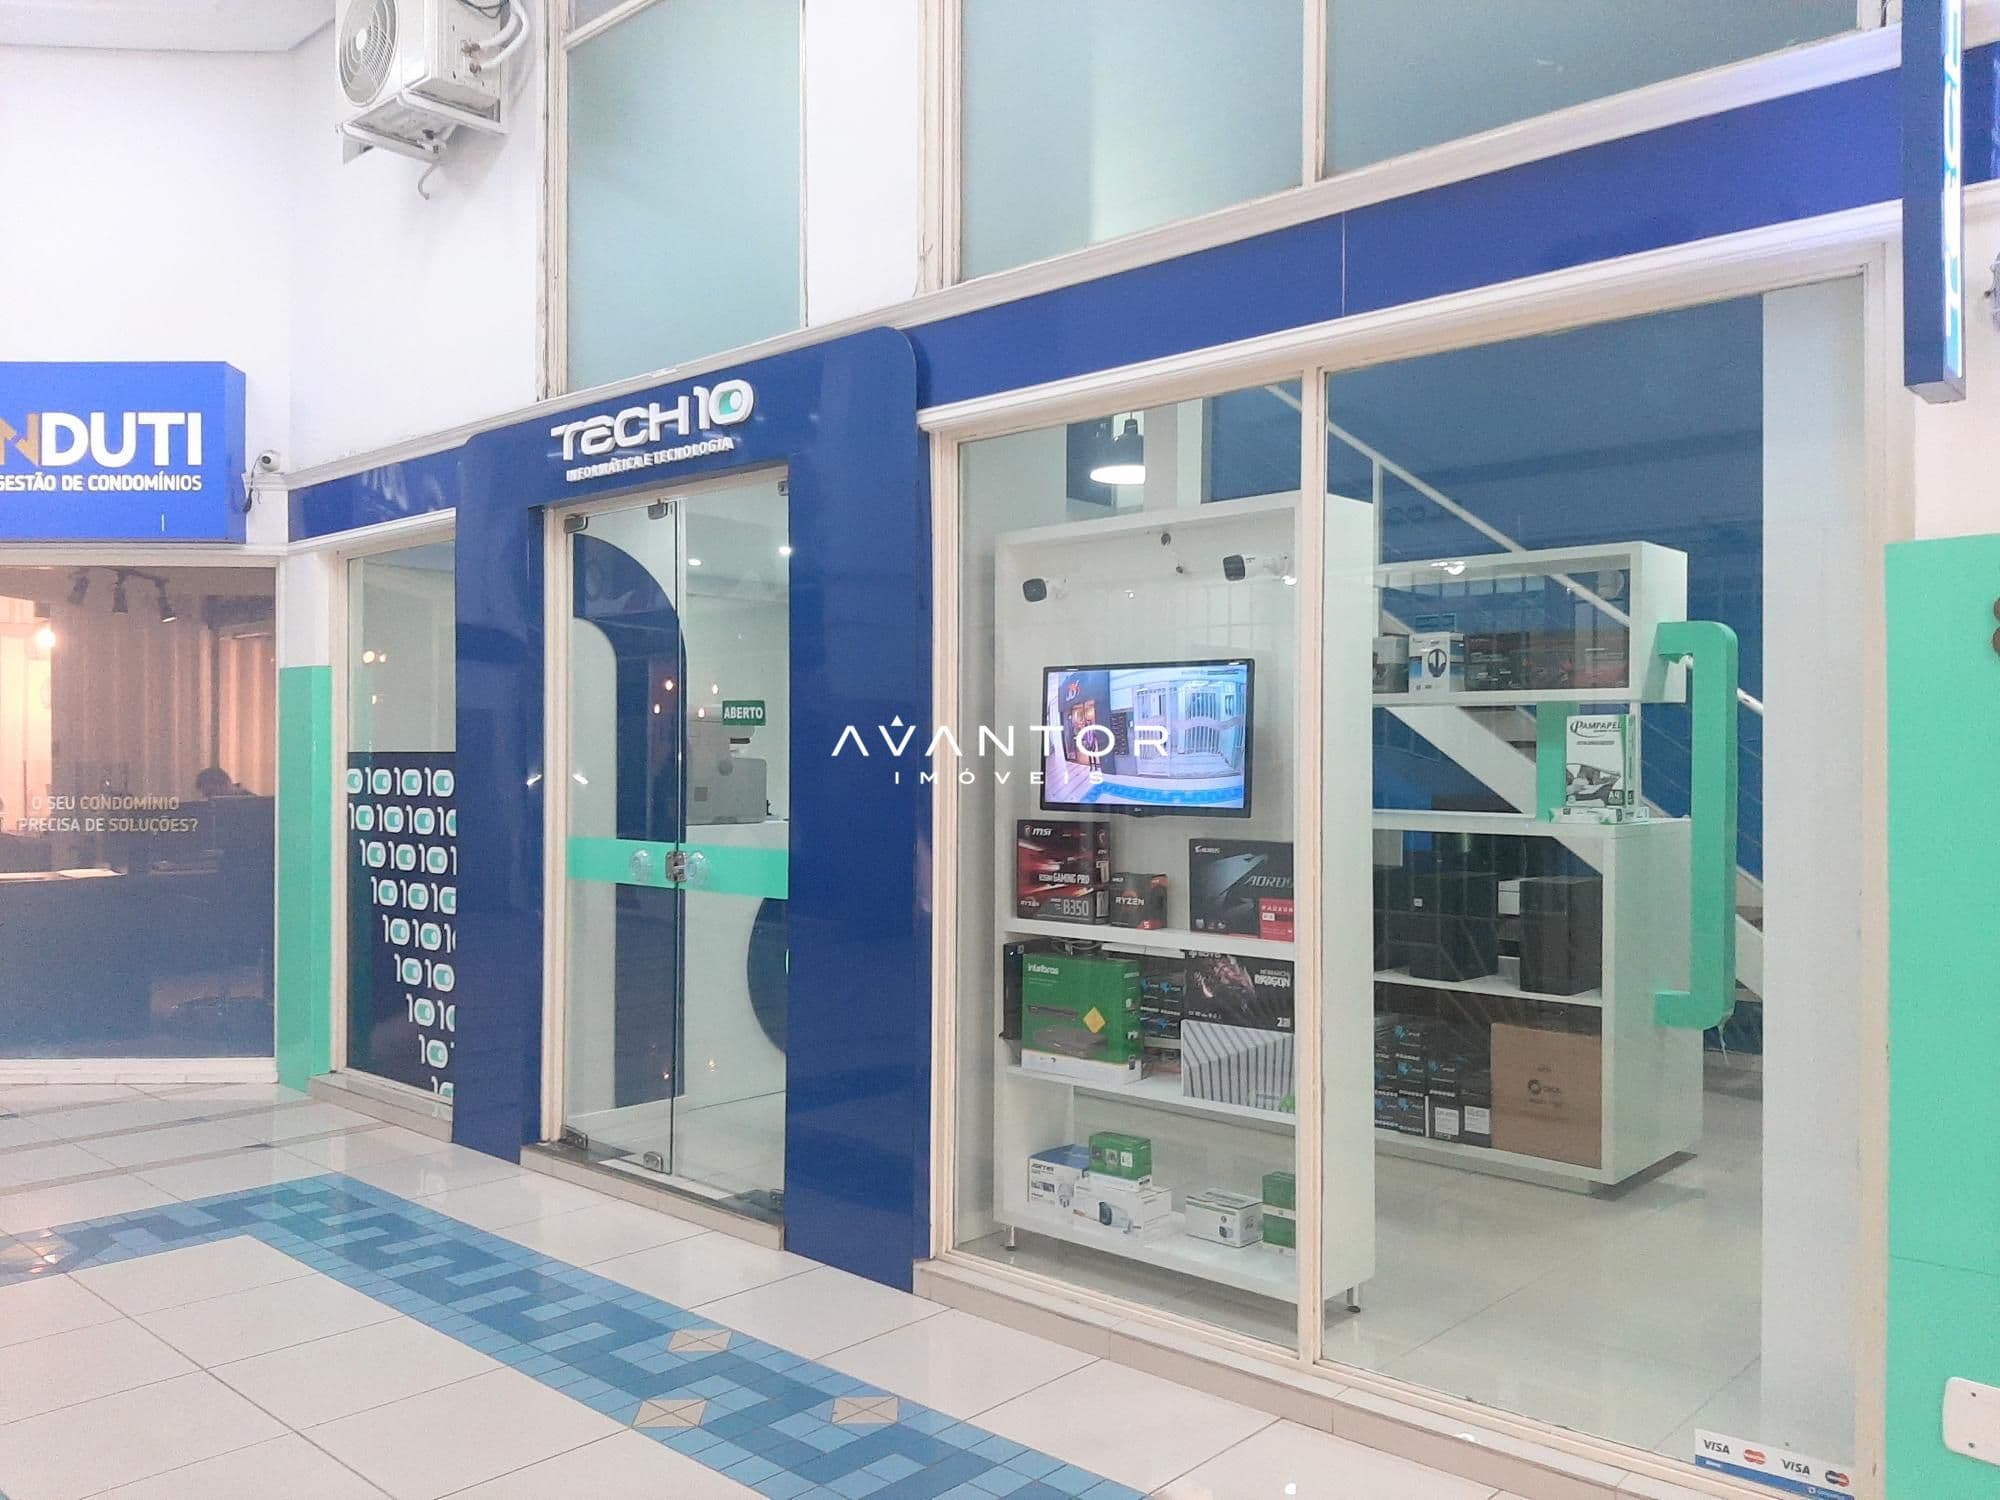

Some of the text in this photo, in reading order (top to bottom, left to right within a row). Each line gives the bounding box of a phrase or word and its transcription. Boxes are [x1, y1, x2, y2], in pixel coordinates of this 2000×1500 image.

[62, 474, 83, 491] DE
[88, 470, 202, 491] CONDOMÍNIOS
[724, 706, 764, 719] ABERTO
[32, 793, 180, 811] O SEU CONDOMÍNIO
[20, 815, 198, 835] PRECISA DE SOLUÇÕES?
[1063, 897, 1089, 917] B350
[1116, 896, 1145, 906] RYZEN
[1703, 1439, 1730, 1455] VISA
[1781, 1459, 1811, 1475] VISA
